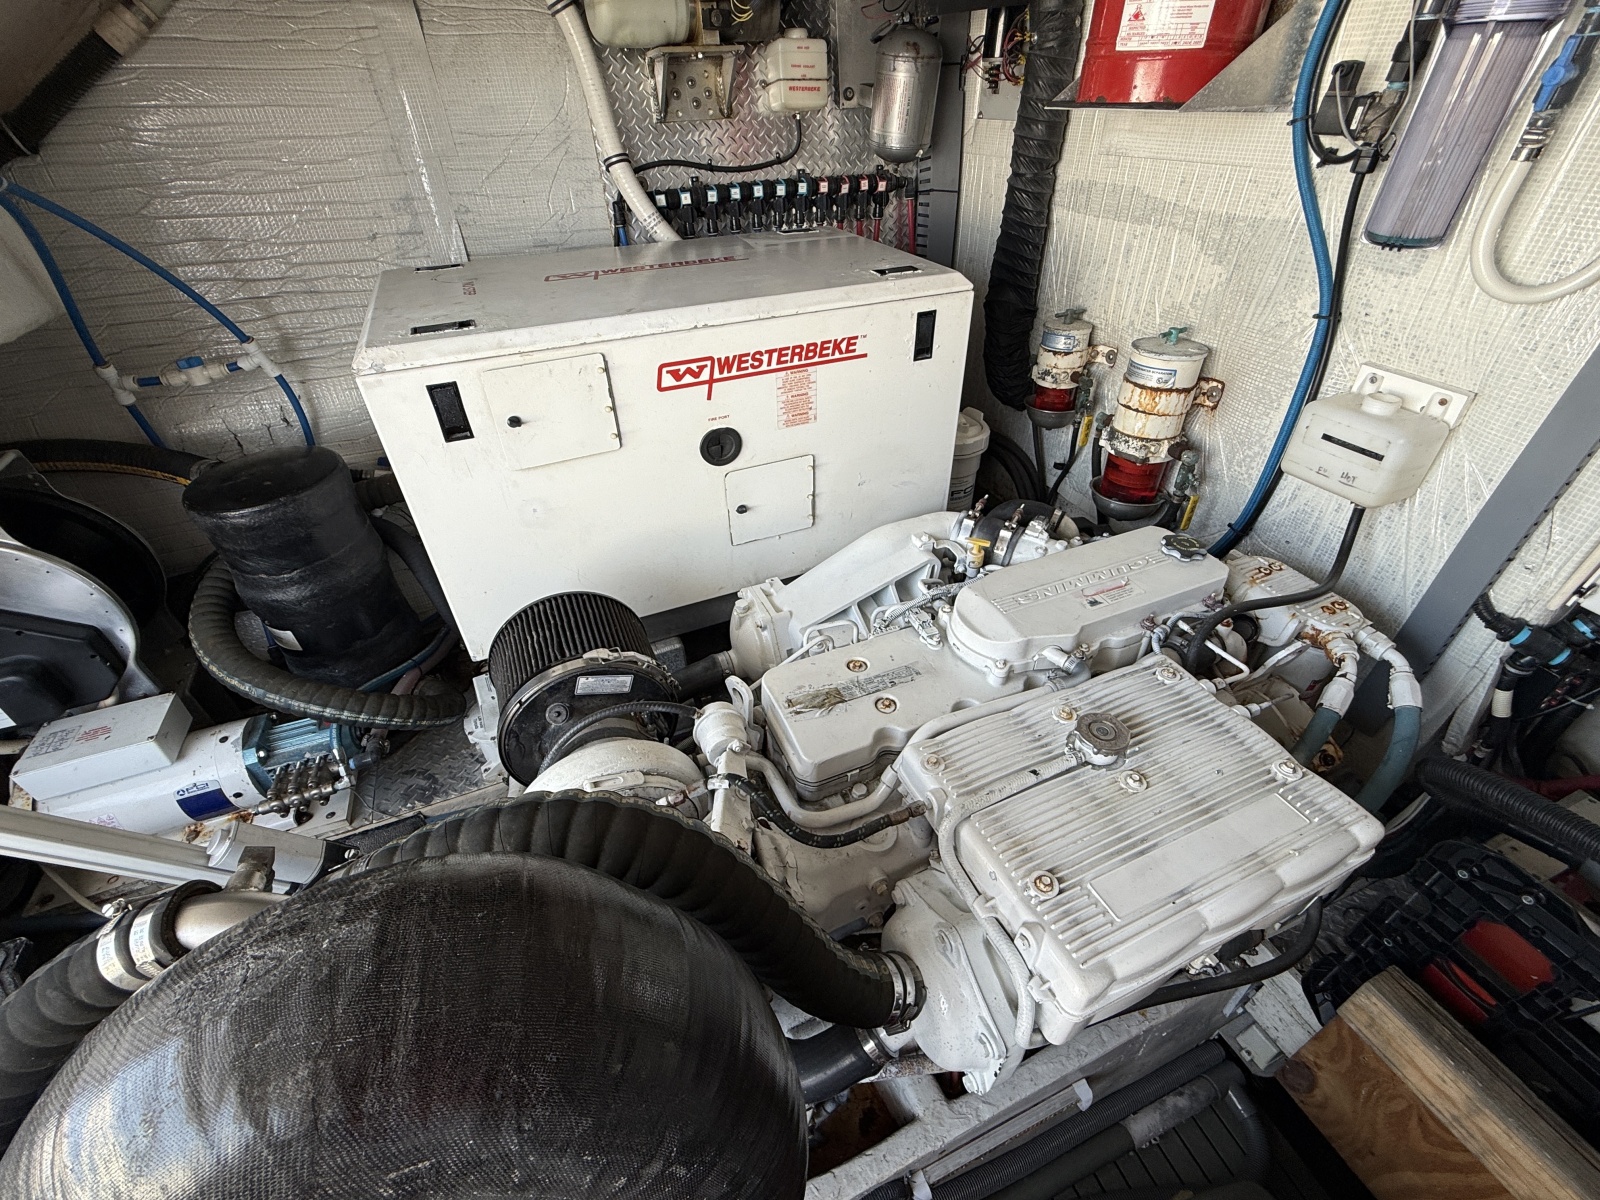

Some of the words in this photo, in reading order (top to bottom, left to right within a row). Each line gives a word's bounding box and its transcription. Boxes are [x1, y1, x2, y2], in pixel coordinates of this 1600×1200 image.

[601, 255, 735, 273] WESTERBEKE
[717, 335, 859, 375] WESTERBEKE
[1016, 559, 1149, 604] CUMMINS
